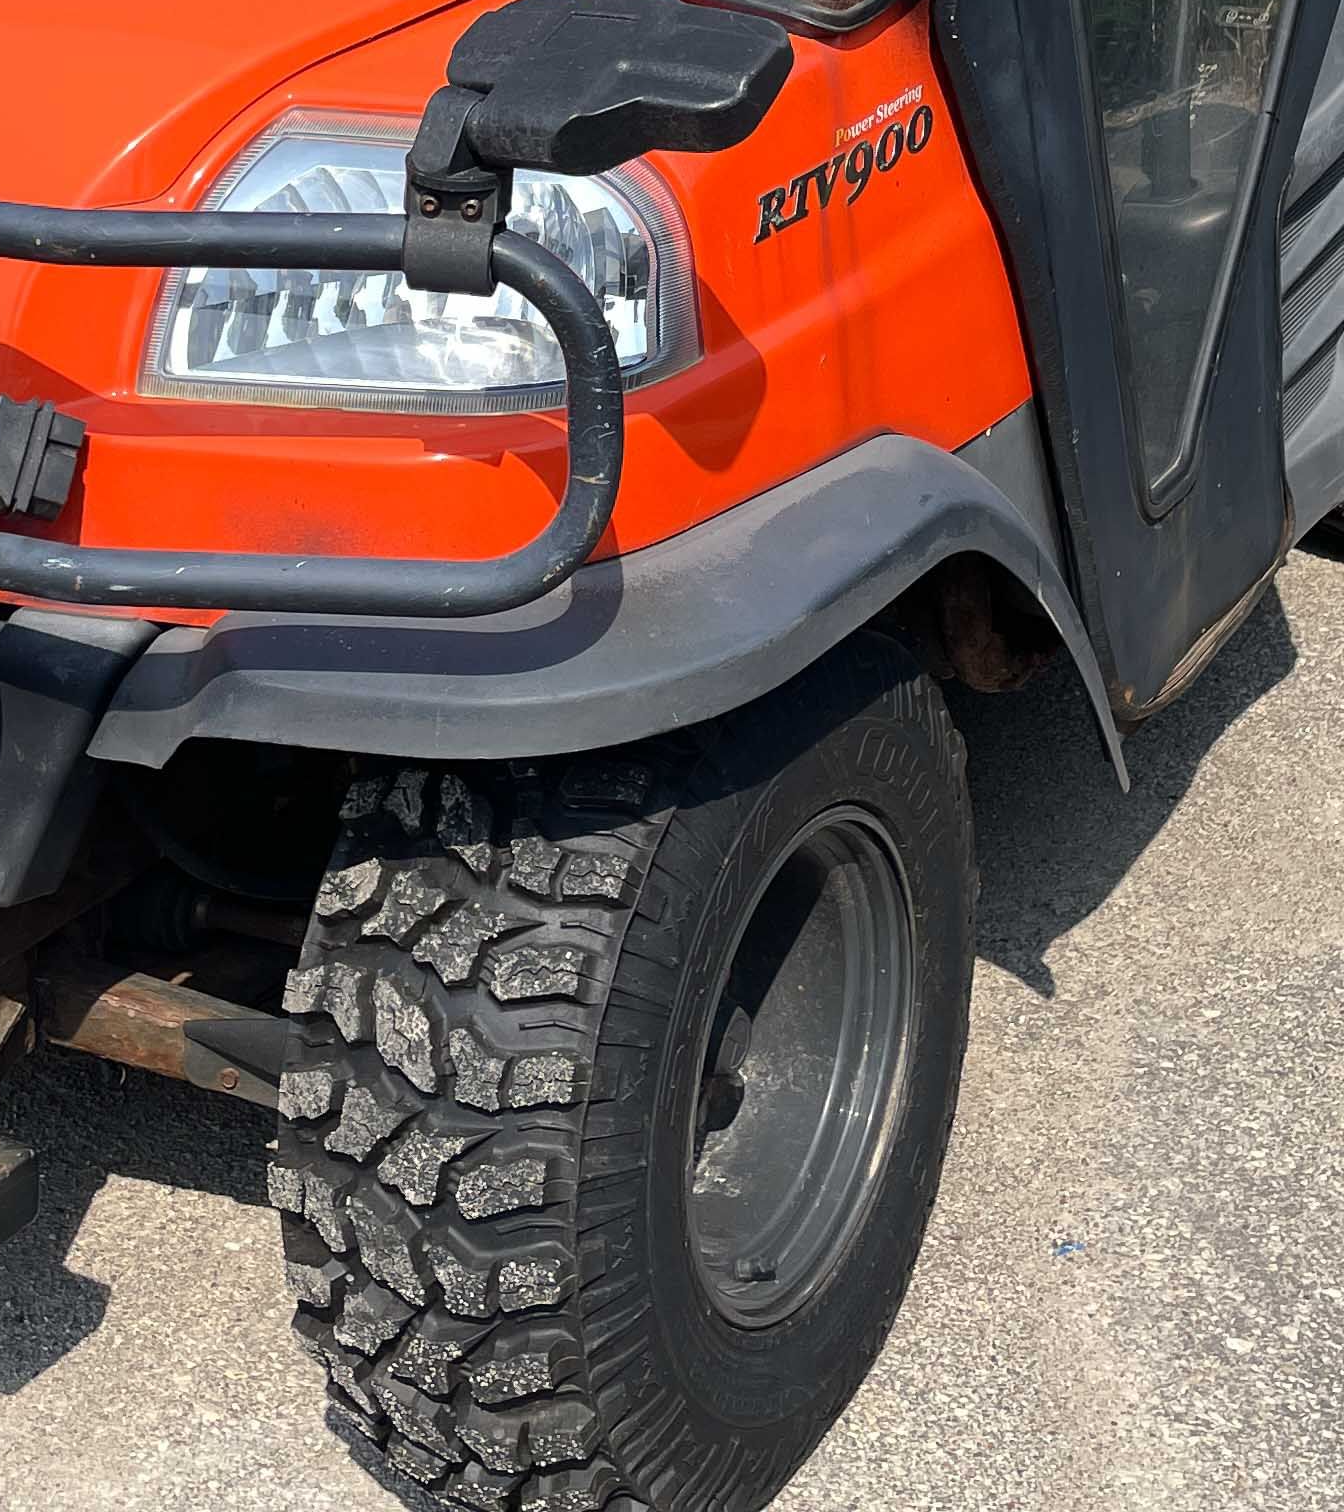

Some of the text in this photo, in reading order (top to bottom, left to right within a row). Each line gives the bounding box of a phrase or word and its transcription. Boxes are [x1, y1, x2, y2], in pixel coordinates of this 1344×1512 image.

[834, 84, 924, 148] Power Steering
[752, 104, 934, 246] RTV900
